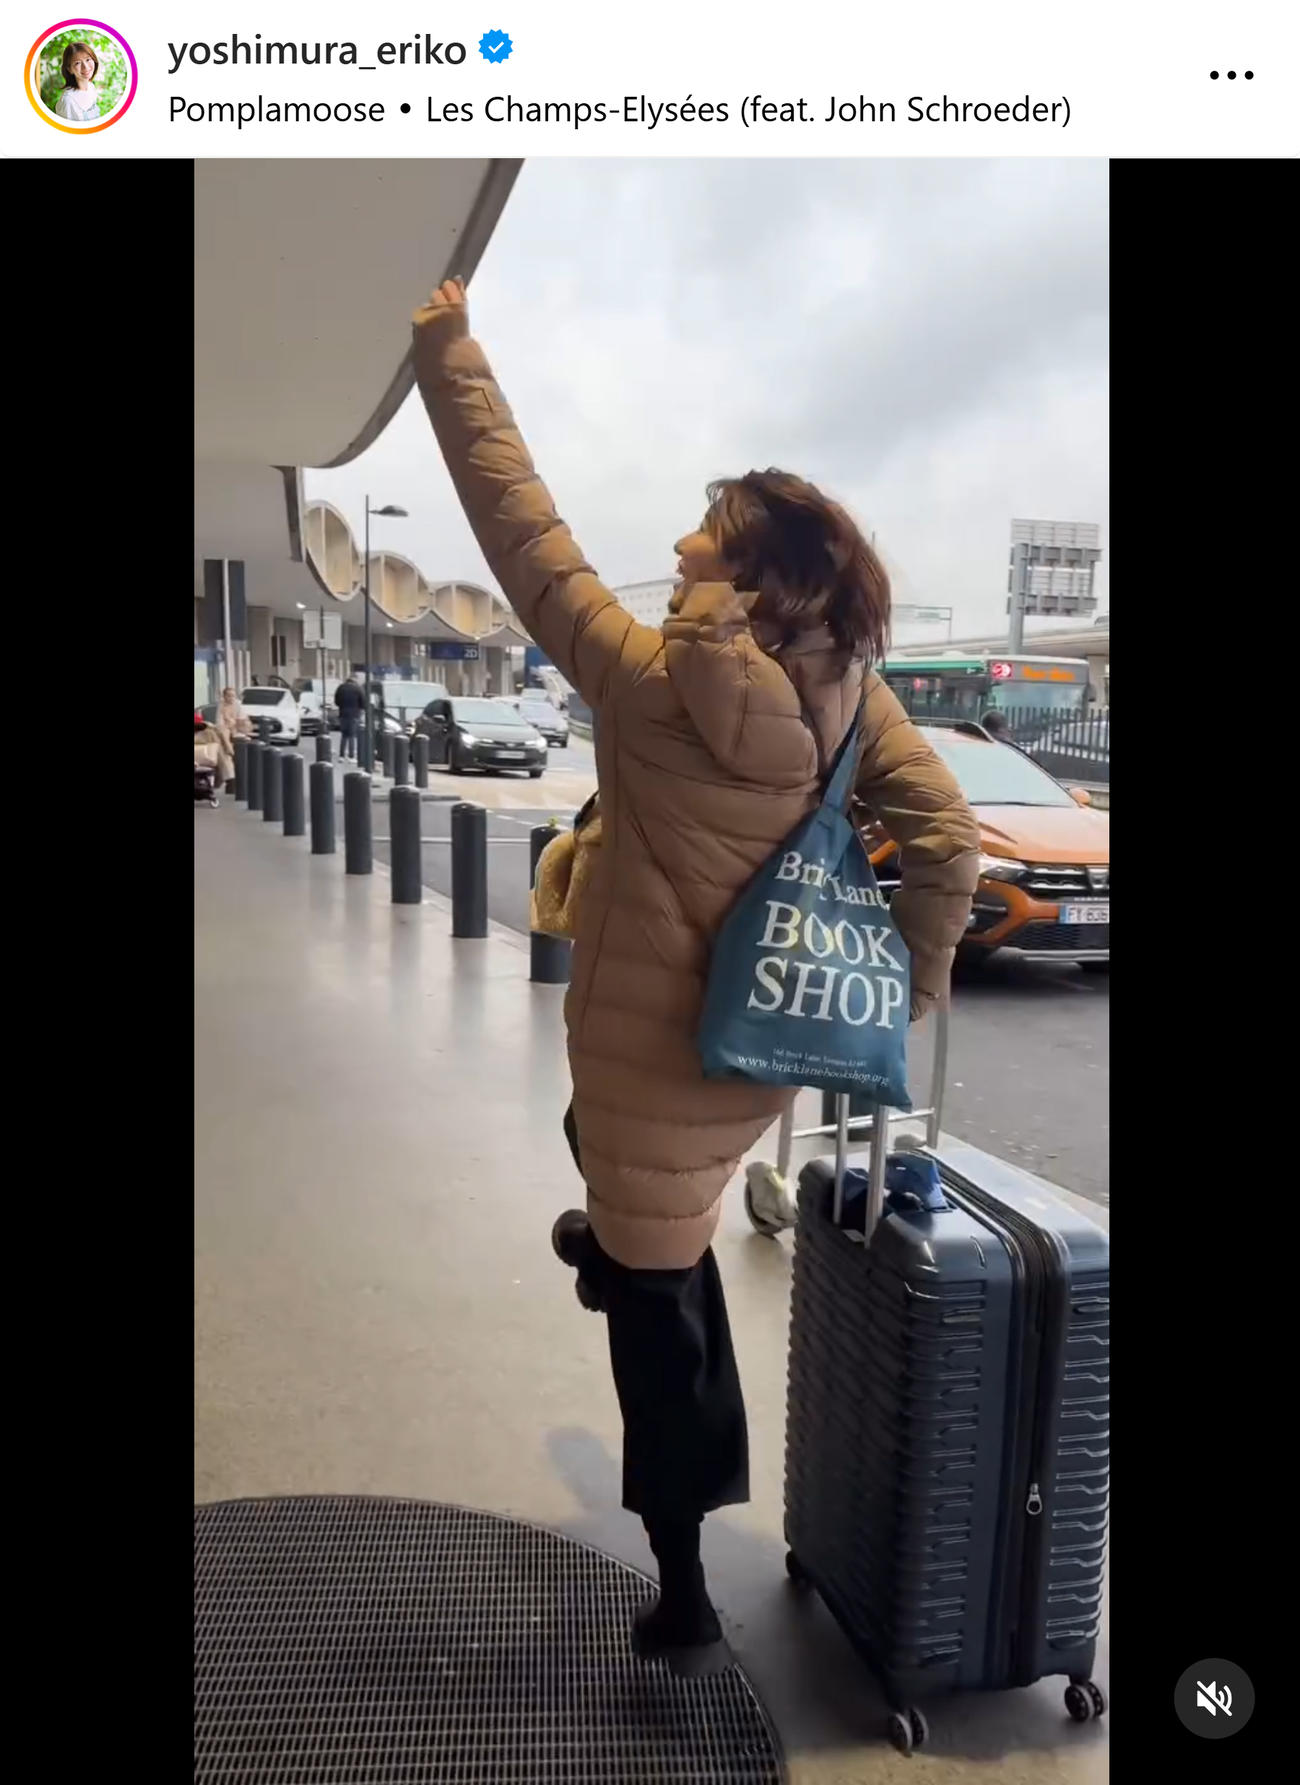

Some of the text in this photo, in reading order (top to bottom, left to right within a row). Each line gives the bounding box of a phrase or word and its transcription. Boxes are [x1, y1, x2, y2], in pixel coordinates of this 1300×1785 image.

[774, 851, 832, 900] Bri
[756, 900, 904, 972] BOOK
[747, 956, 903, 1029] SHOP
